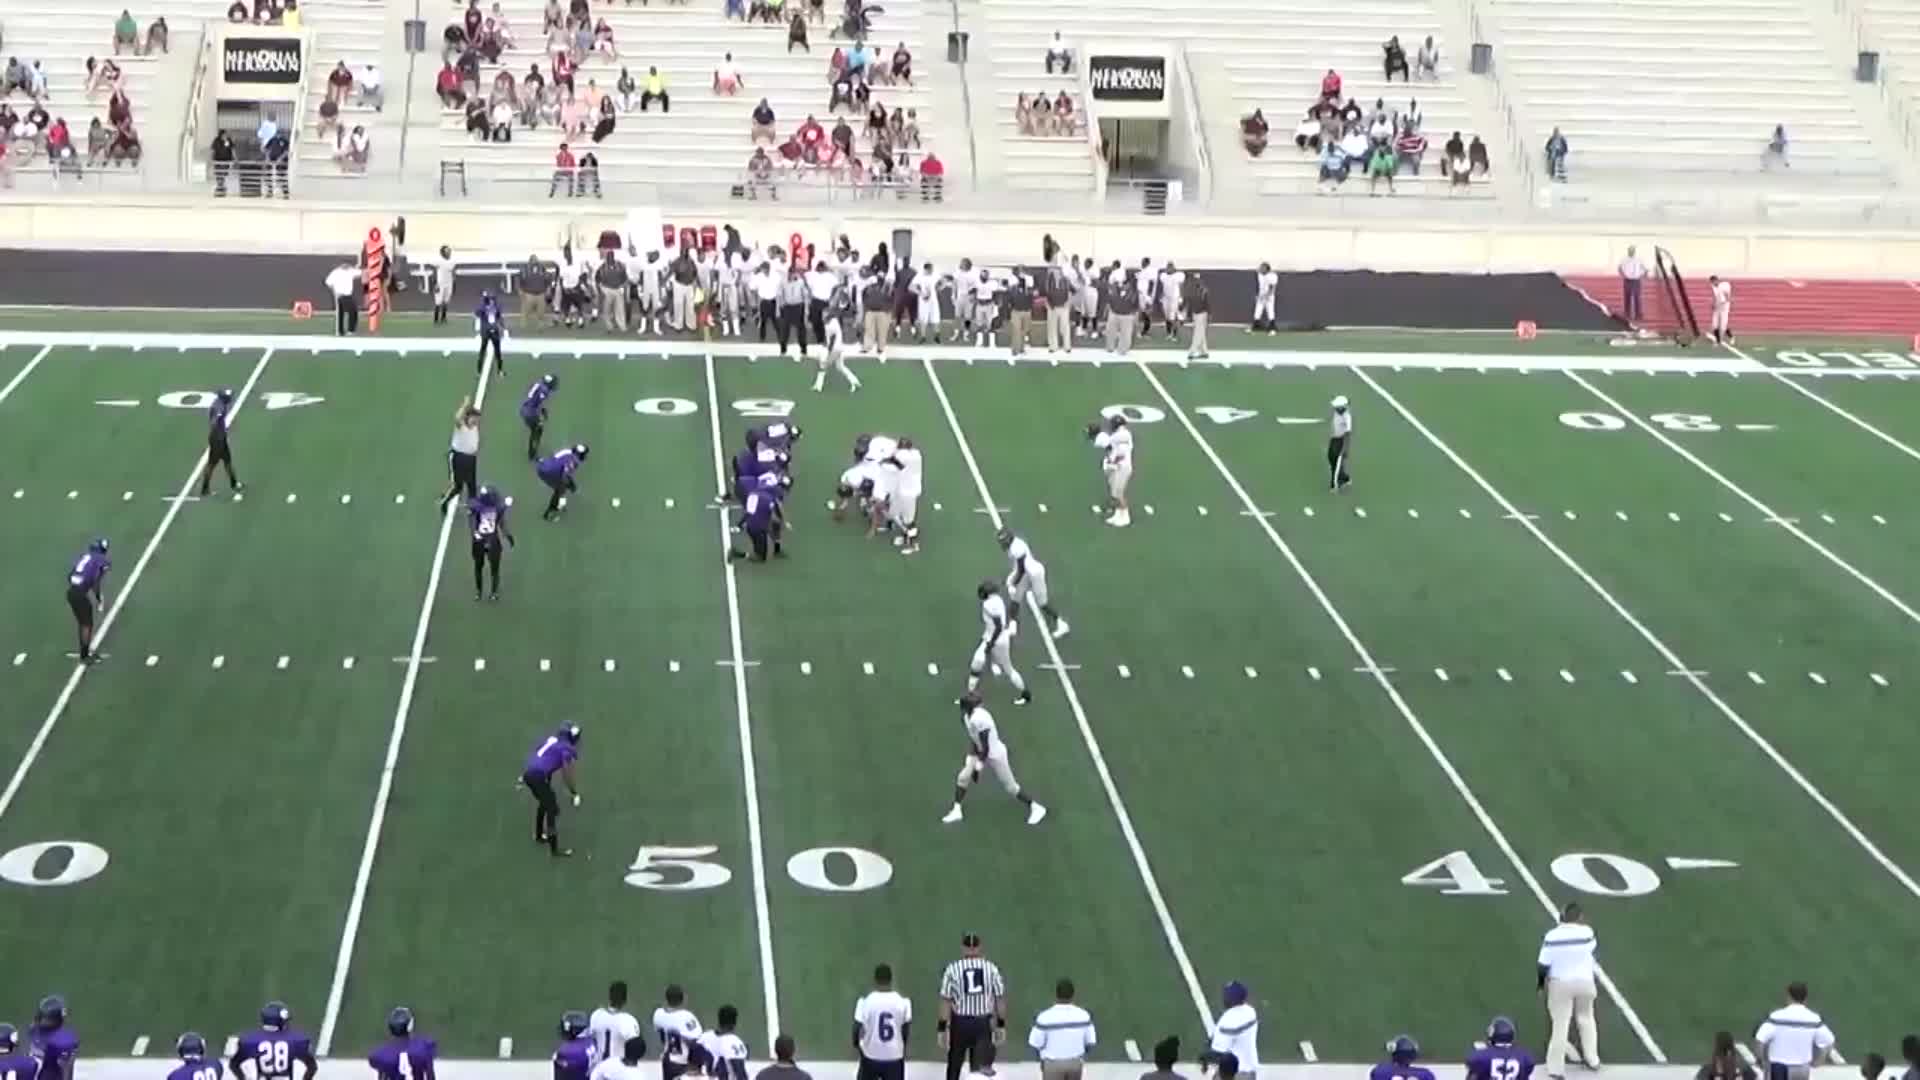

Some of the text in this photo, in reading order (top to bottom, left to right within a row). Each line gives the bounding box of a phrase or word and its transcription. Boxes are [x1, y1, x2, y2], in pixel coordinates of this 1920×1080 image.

[966, 971, 983, 993] L
[878, 1012, 894, 1042] 6
[258, 1040, 289, 1073] 28
